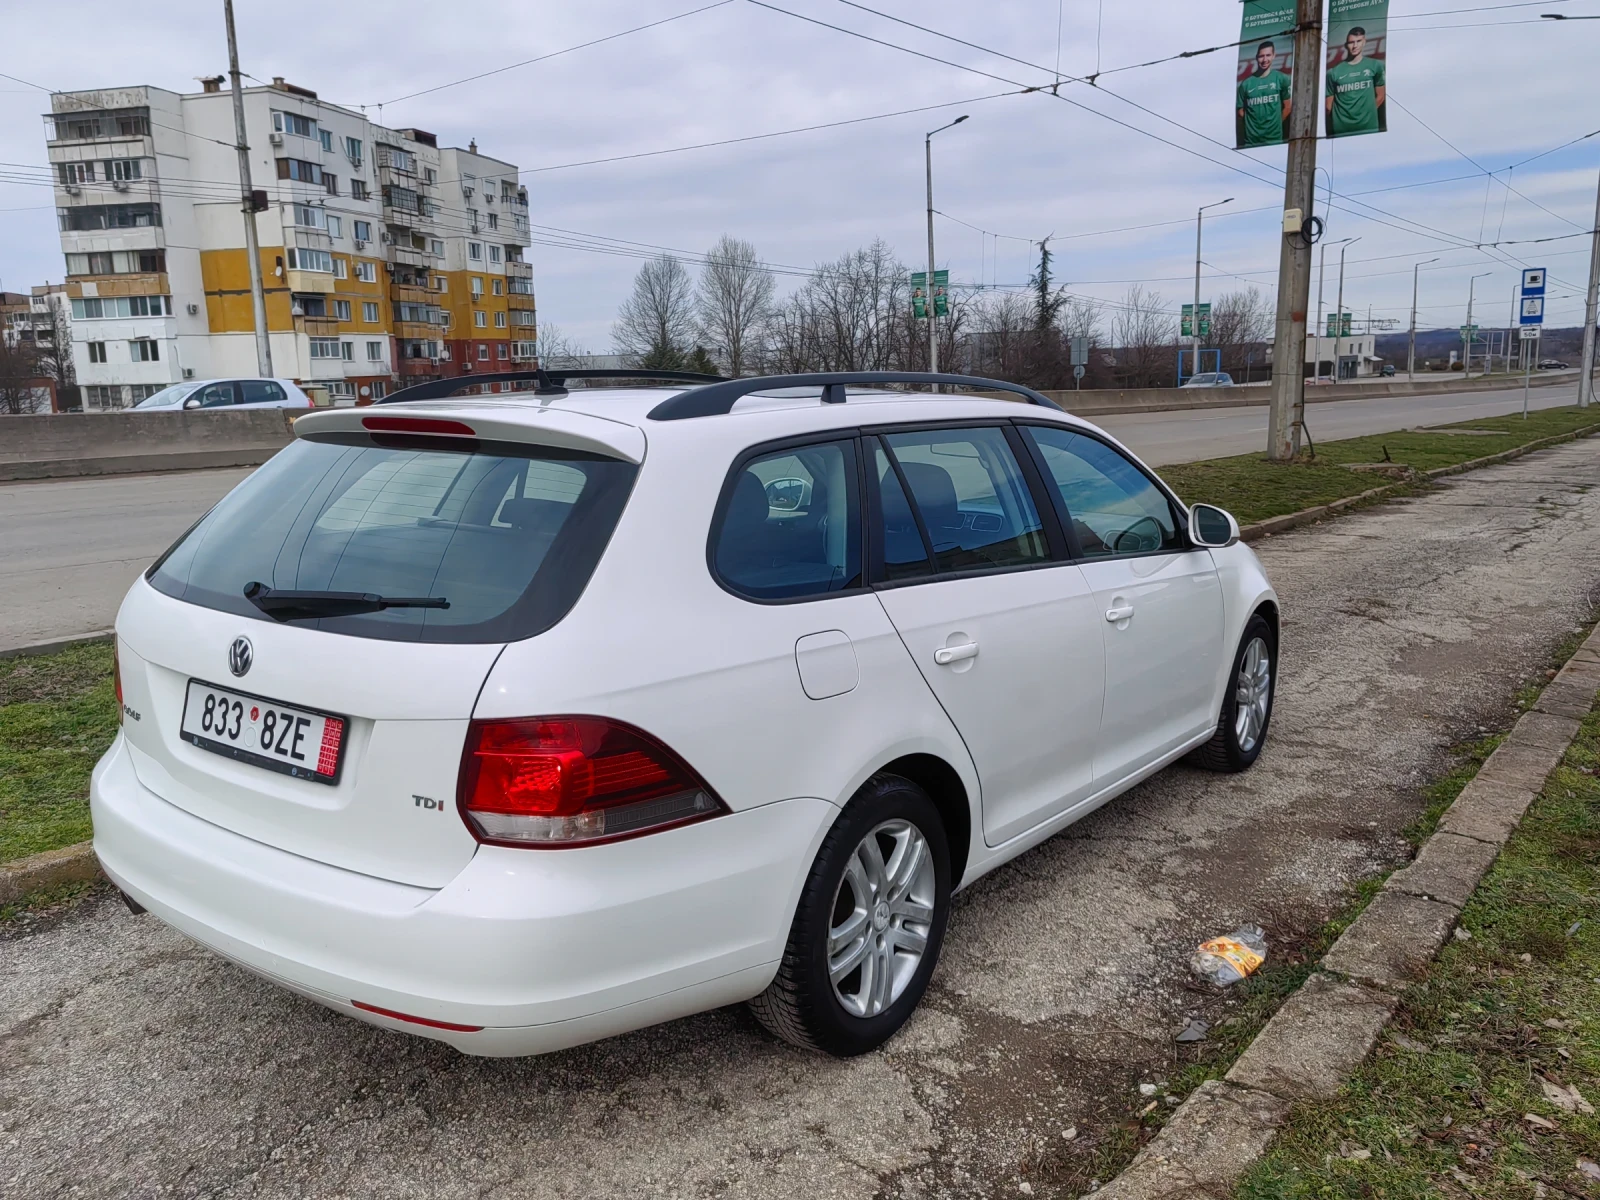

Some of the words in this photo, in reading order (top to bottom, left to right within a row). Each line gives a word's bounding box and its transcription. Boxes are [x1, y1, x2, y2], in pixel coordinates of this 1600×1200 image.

[1336, 80, 1372, 93] WINBET
[1247, 94, 1279, 106] WINBET
[202, 694, 244, 740] 833
[261, 710, 311, 761] 8ZE
[411, 794, 444, 812] TDI
